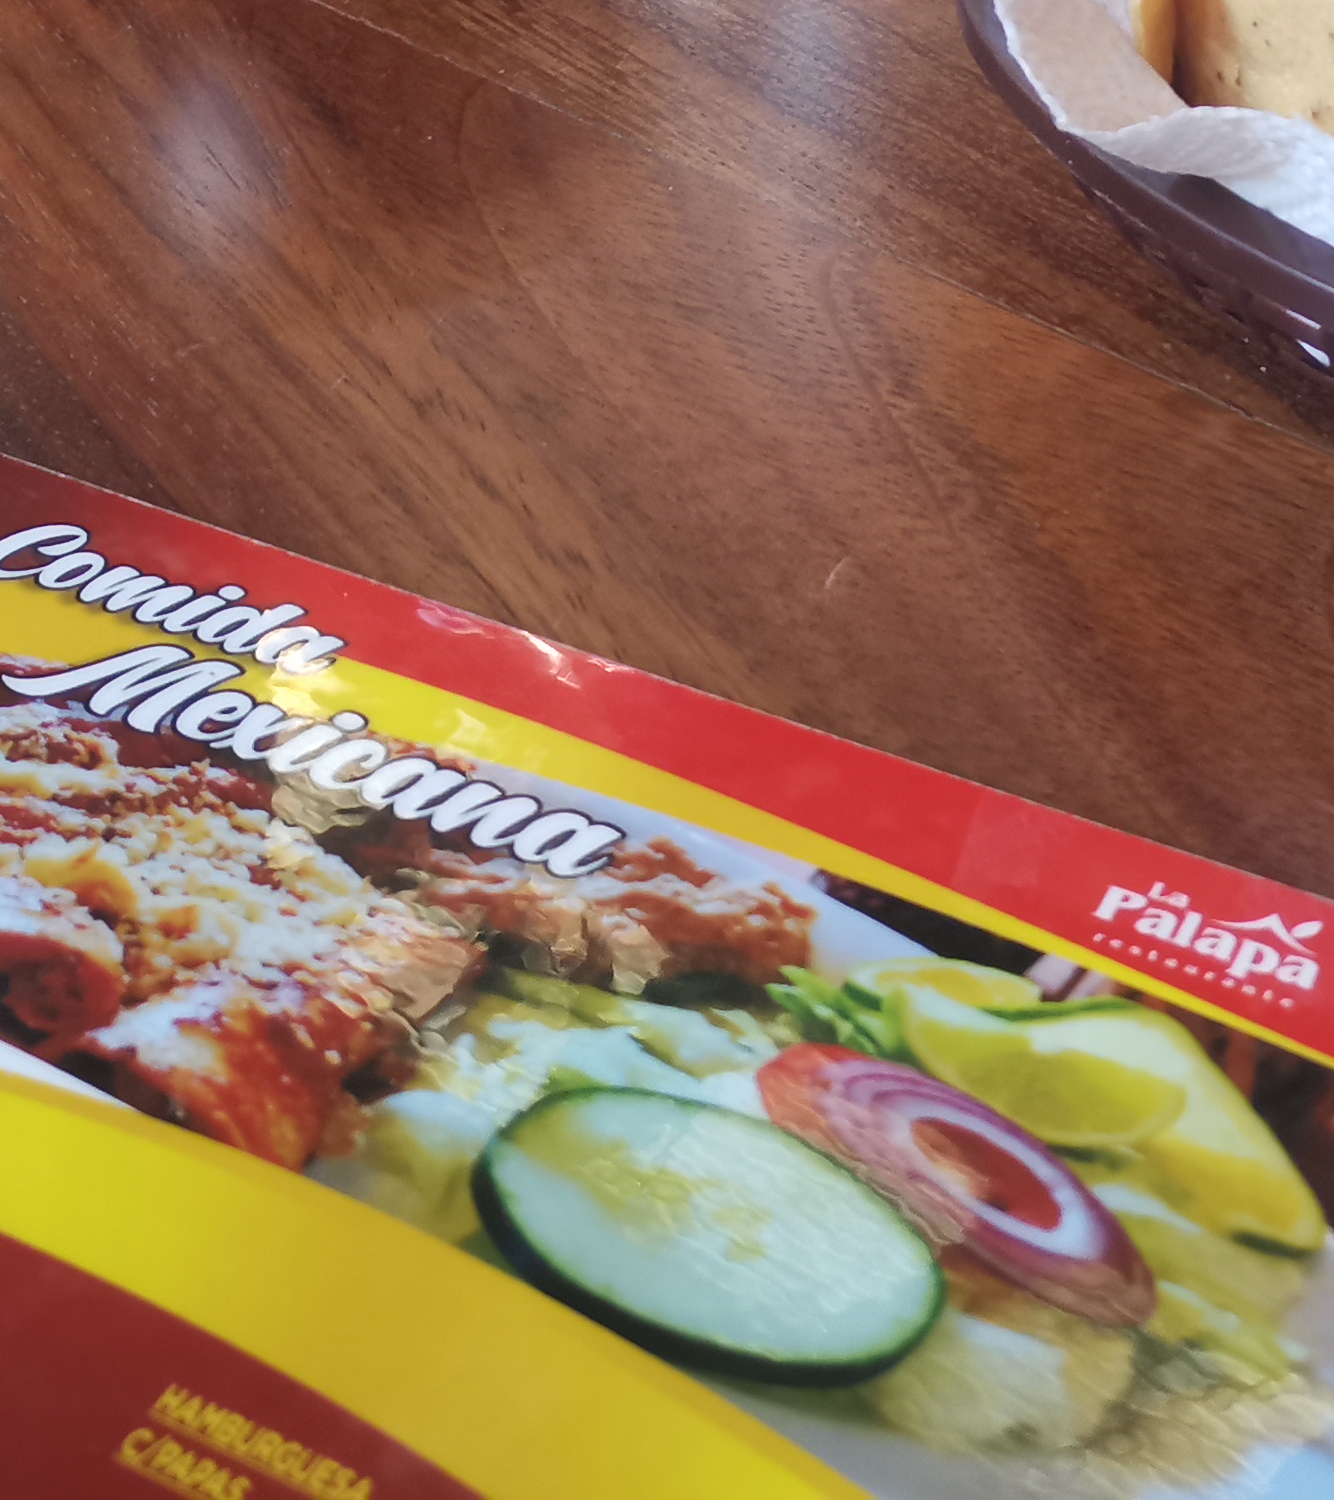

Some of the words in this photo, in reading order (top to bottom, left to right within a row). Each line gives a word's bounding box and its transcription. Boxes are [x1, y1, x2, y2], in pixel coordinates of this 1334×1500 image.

[1, 642, 627, 879] Mexicana
[1092, 885, 1320, 990] Palapa
[1147, 881, 1191, 909] La
